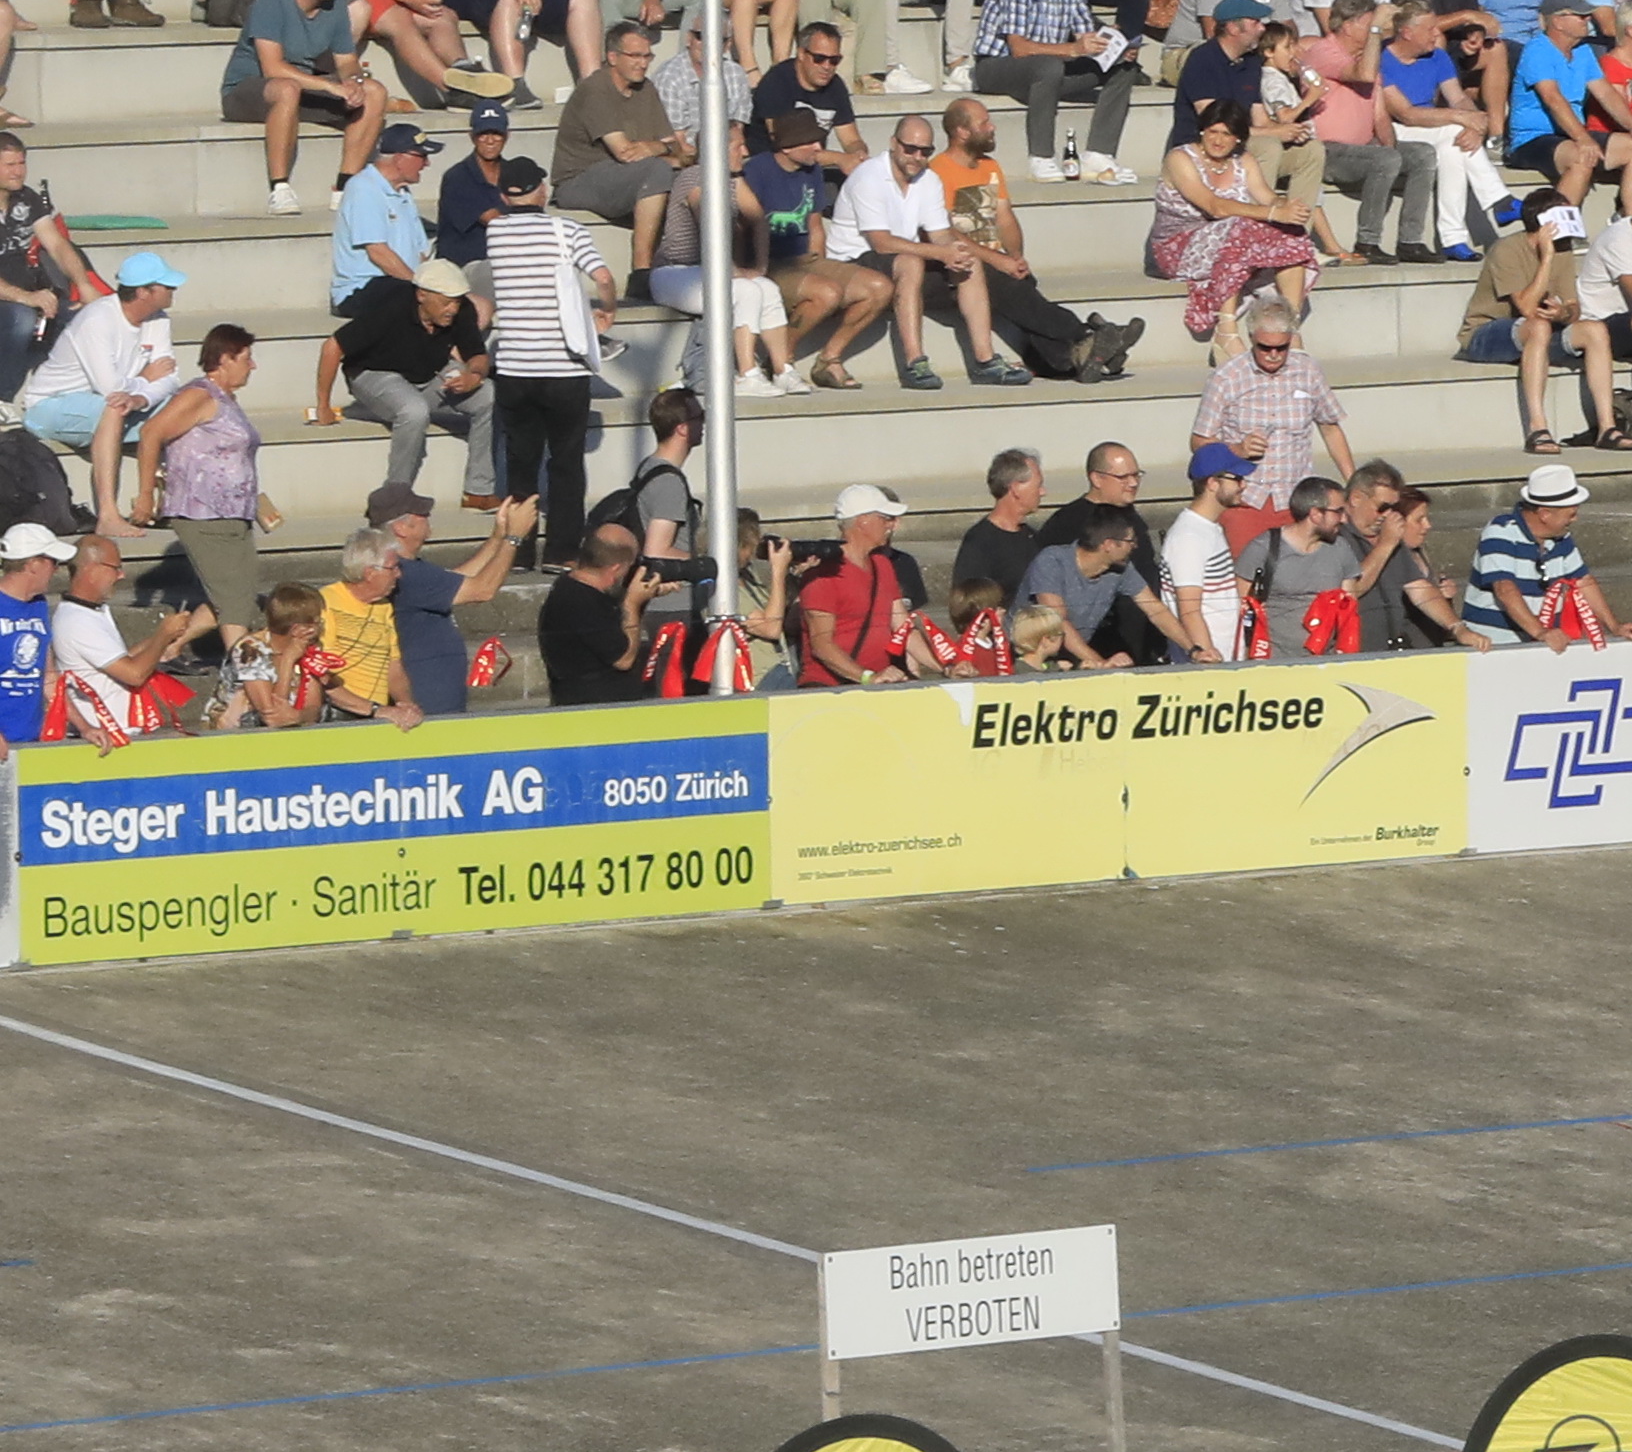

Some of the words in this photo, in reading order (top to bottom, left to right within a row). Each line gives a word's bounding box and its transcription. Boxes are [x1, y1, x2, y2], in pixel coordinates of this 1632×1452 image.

[972, 703, 1117, 749] Elektro
[1131, 678, 1324, 739] Zürichsee
[41, 798, 186, 854] Steger
[206, 775, 464, 837] Haustechnik
[482, 767, 544, 814] AG
[604, 777, 668, 807] 8050
[676, 770, 749, 803] Zürich
[1375, 825, 1439, 841] Burkhalter
[798, 833, 962, 859] www.elektro-zuerichsee.ch
[42, 885, 278, 940] Bauspengler
[312, 870, 436, 919] Sanitär
[459, 865, 516, 907] Tel.
[528, 861, 586, 901] 044
[598, 854, 654, 896] 317
[666, 851, 702, 891] 80
[716, 846, 753, 885] 00
[890, 1249, 949, 1291] Bahn
[958, 1242, 1054, 1287] betreten
[907, 1295, 1041, 1345] VERBOTEN
